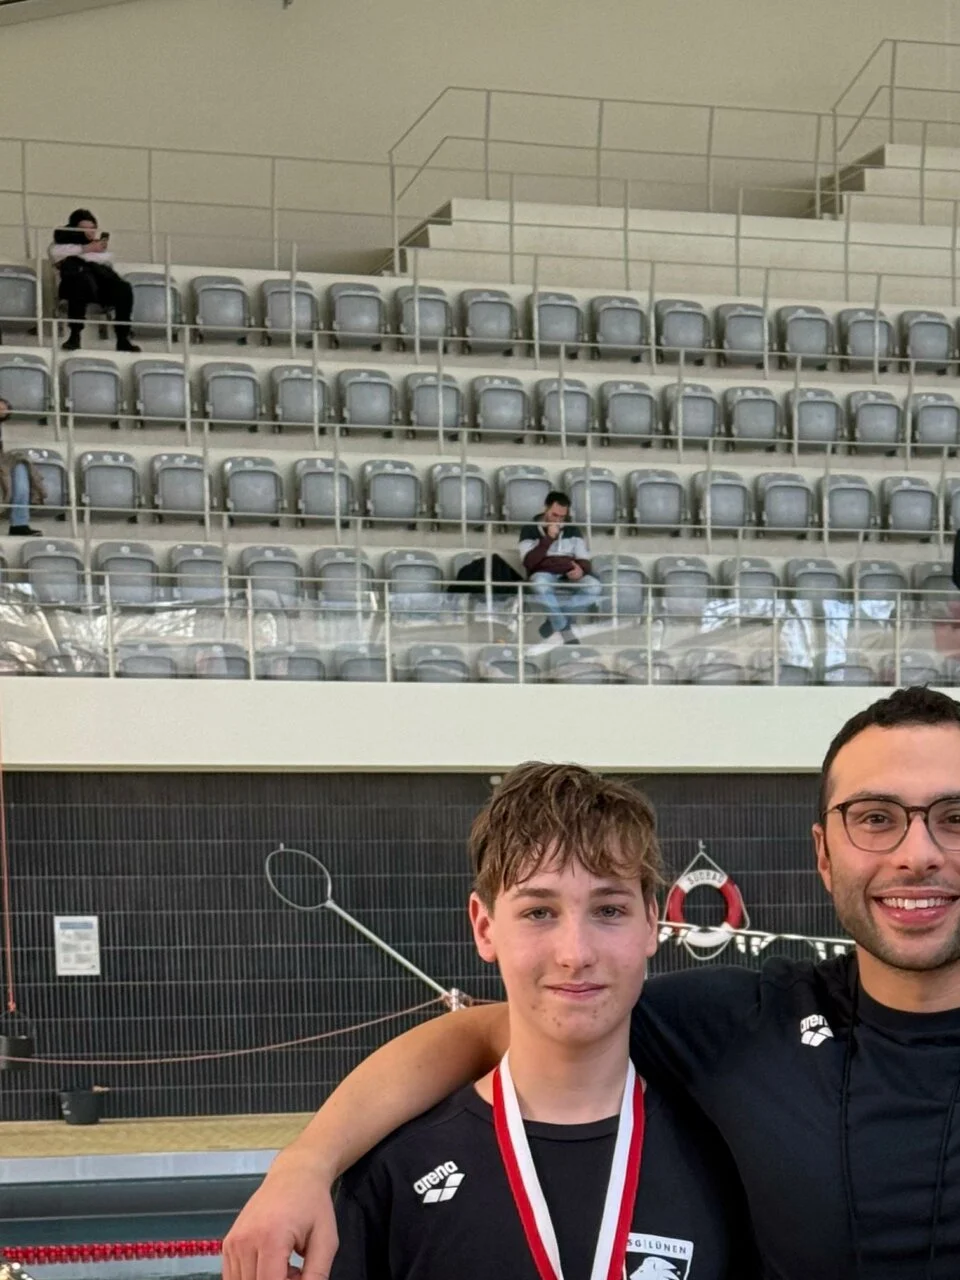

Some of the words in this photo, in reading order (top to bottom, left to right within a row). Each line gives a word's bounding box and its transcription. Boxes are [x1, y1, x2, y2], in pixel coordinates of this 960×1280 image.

[800, 1014, 829, 1034] aren
[413, 1160, 459, 1195] arena
[648, 1240, 687, 1255] LÜNEN
